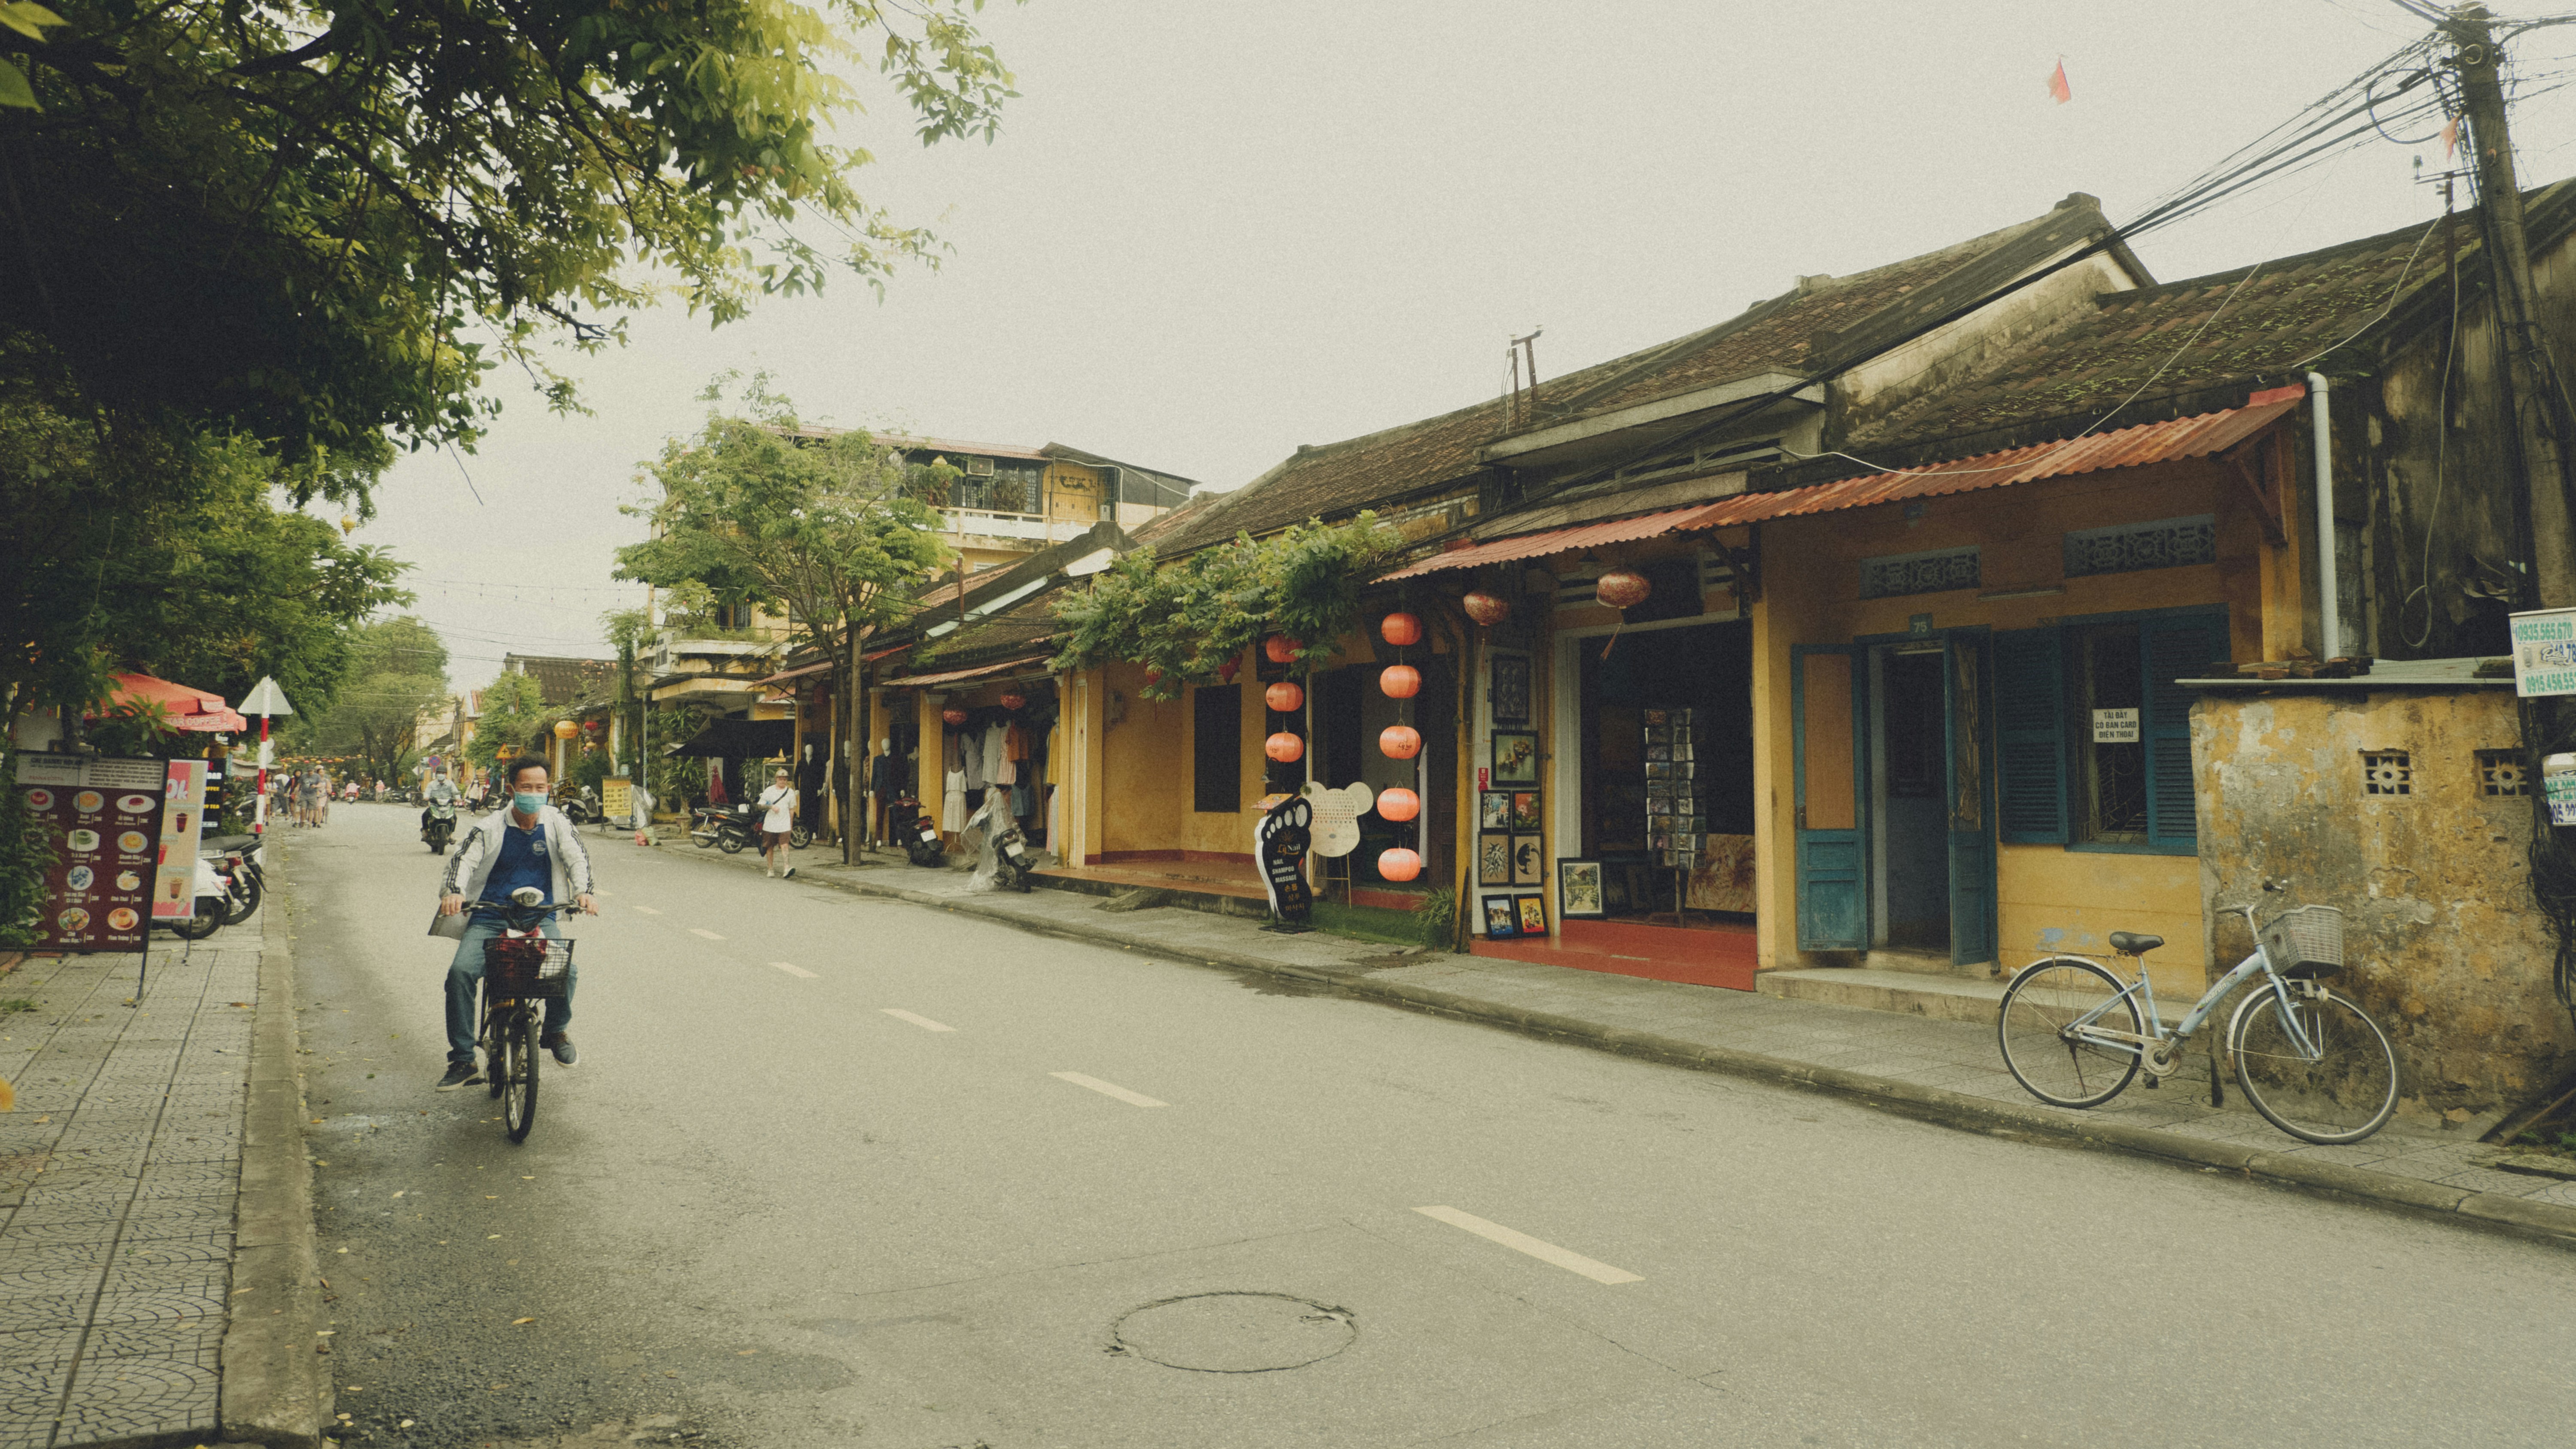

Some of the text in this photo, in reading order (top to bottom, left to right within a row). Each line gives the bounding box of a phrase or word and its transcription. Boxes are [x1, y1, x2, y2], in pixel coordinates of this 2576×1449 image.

[1914, 621, 1927, 632] 75
[2518, 622, 2573, 641] 0935.565.670
[2525, 671, 2576, 694] 0915.456.55
[185, 715, 221, 726] COFFEE
[2099, 730, 2134, 740] ĐIỆN THOẠI
[1287, 843, 1301, 851] Nail
[1272, 866, 1294, 875] SHAMPOO
[1275, 874, 1297, 883] MASSAGE
[1285, 903, 1305, 912] 마사지
